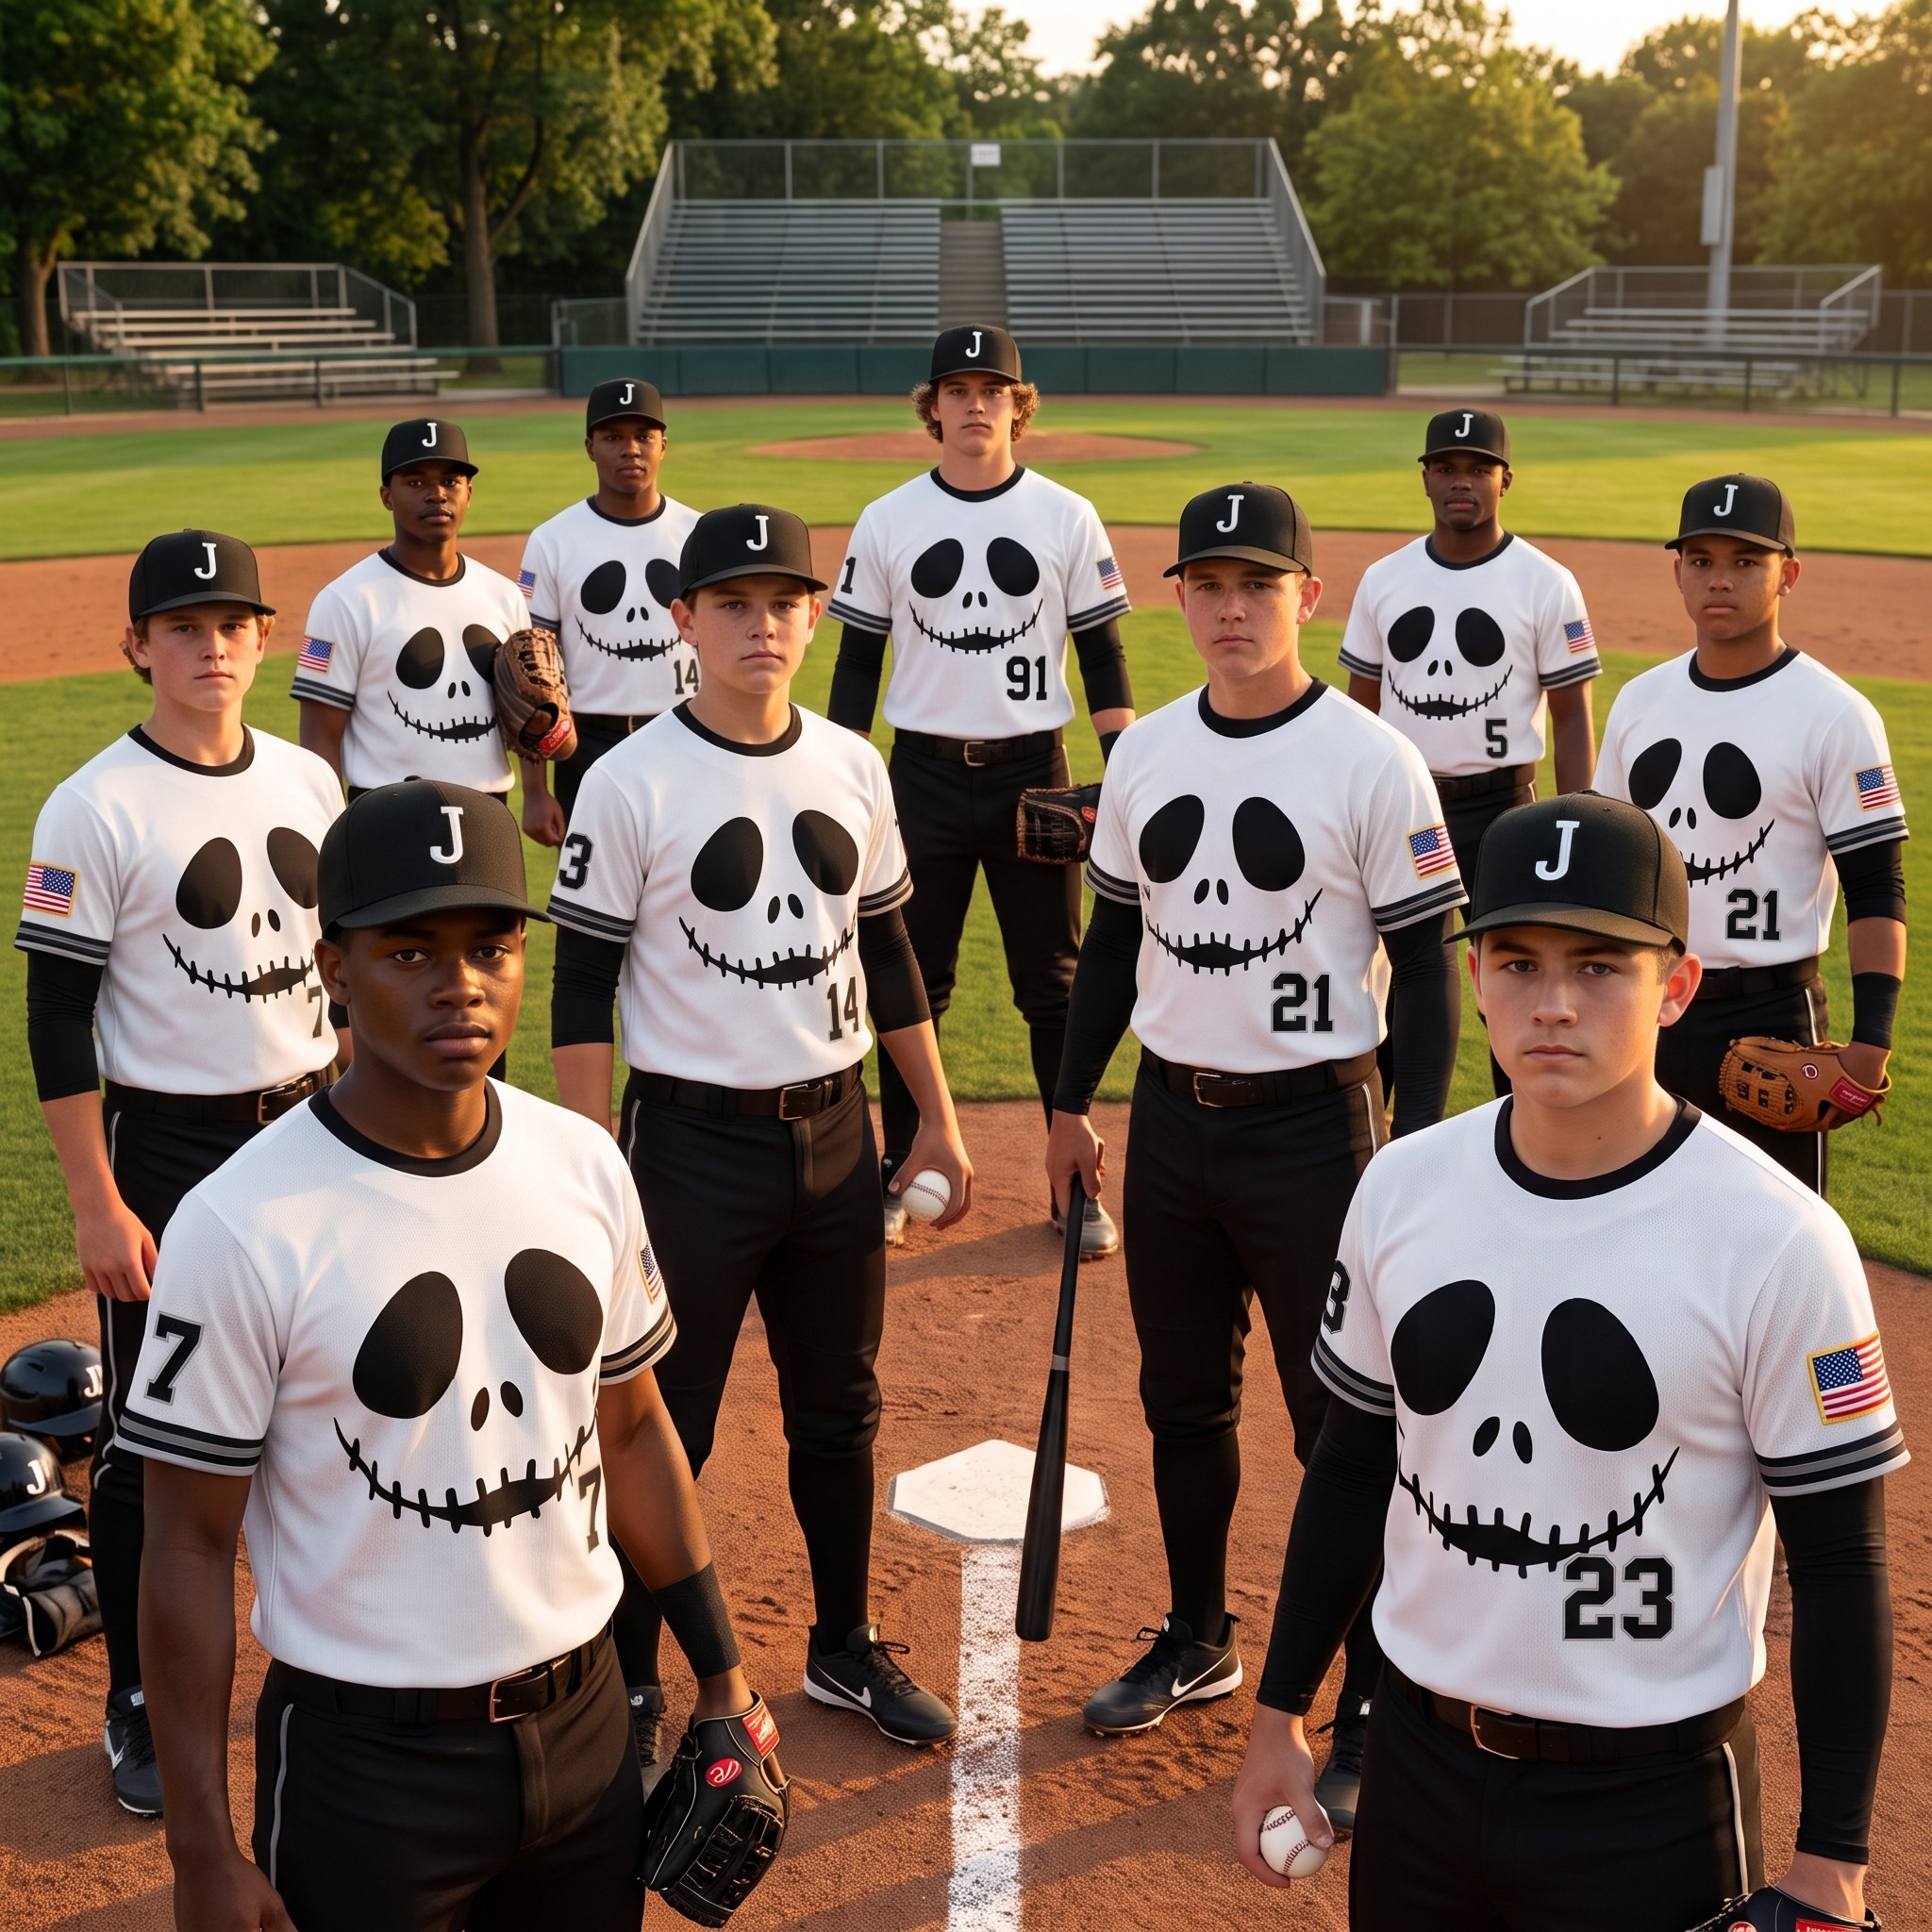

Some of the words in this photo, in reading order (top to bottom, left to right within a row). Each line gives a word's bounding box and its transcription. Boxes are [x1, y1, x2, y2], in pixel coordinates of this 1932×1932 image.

[965, 330, 983, 358] J
[619, 383, 635, 405] J
[422, 421, 438, 448] J
[1455, 413, 1474, 438] J
[1216, 494, 1245, 533] J
[1713, 483, 1739, 517] J
[745, 514, 770, 551] J
[193, 541, 217, 580] J
[841, 556, 857, 594] 1
[674, 658, 699, 694] 14
[1006, 656, 1047, 700] 91
[1485, 717, 1508, 758] 5
[429, 806, 464, 864] J
[1535, 820, 1580, 881] J
[558, 832, 593, 891] 3
[1724, 887, 1781, 941] 21
[307, 984, 324, 1039] 7
[826, 976, 859, 1042] 14
[1271, 972, 1334, 1033] 21
[143, 1311, 205, 1406] 7
[26, 1459, 45, 1495] J
[578, 1463, 601, 1553] 7
[1562, 1554, 1674, 1641] 23
